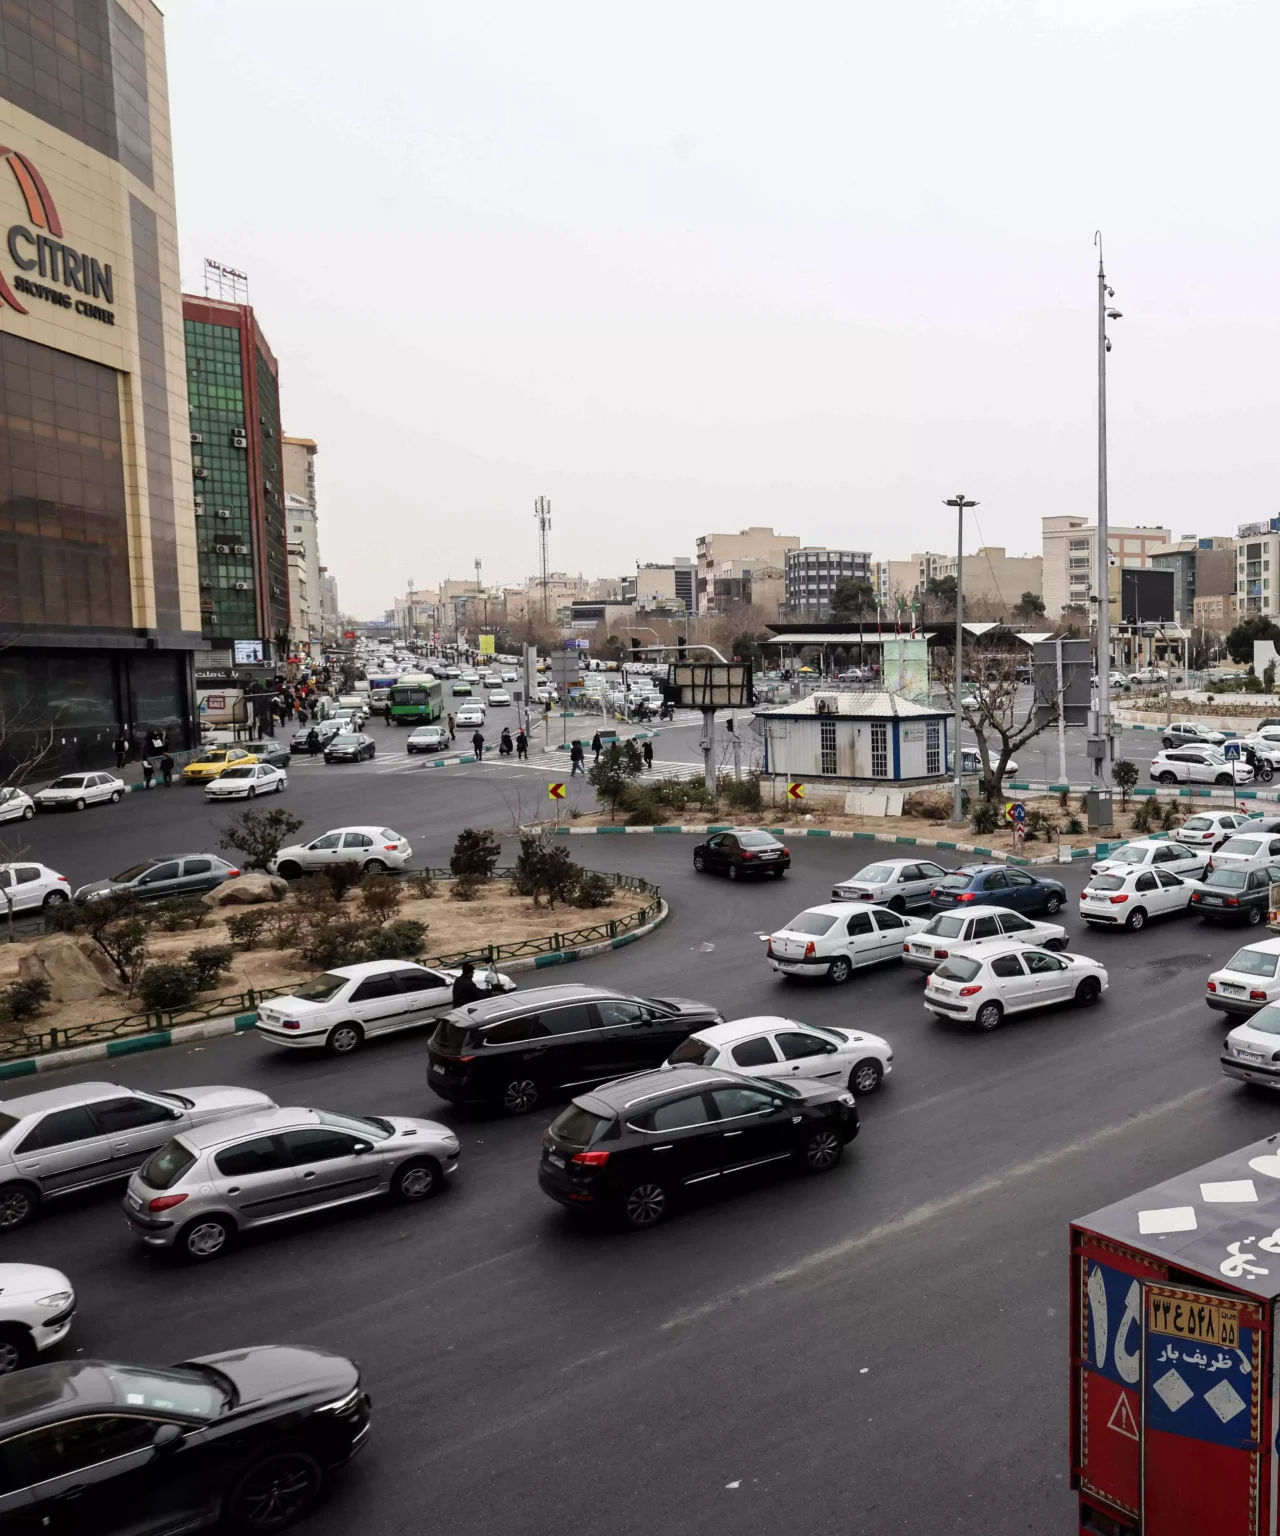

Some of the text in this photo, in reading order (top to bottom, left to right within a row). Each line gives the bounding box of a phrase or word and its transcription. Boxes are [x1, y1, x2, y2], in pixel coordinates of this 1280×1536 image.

[7, 225, 114, 304] CITRIN
[14, 275, 116, 326] SHOPPING CENTER
[1220, 1322, 1235, 1345] ۵۵
[1156, 1343, 1233, 1372] ظریف بار
